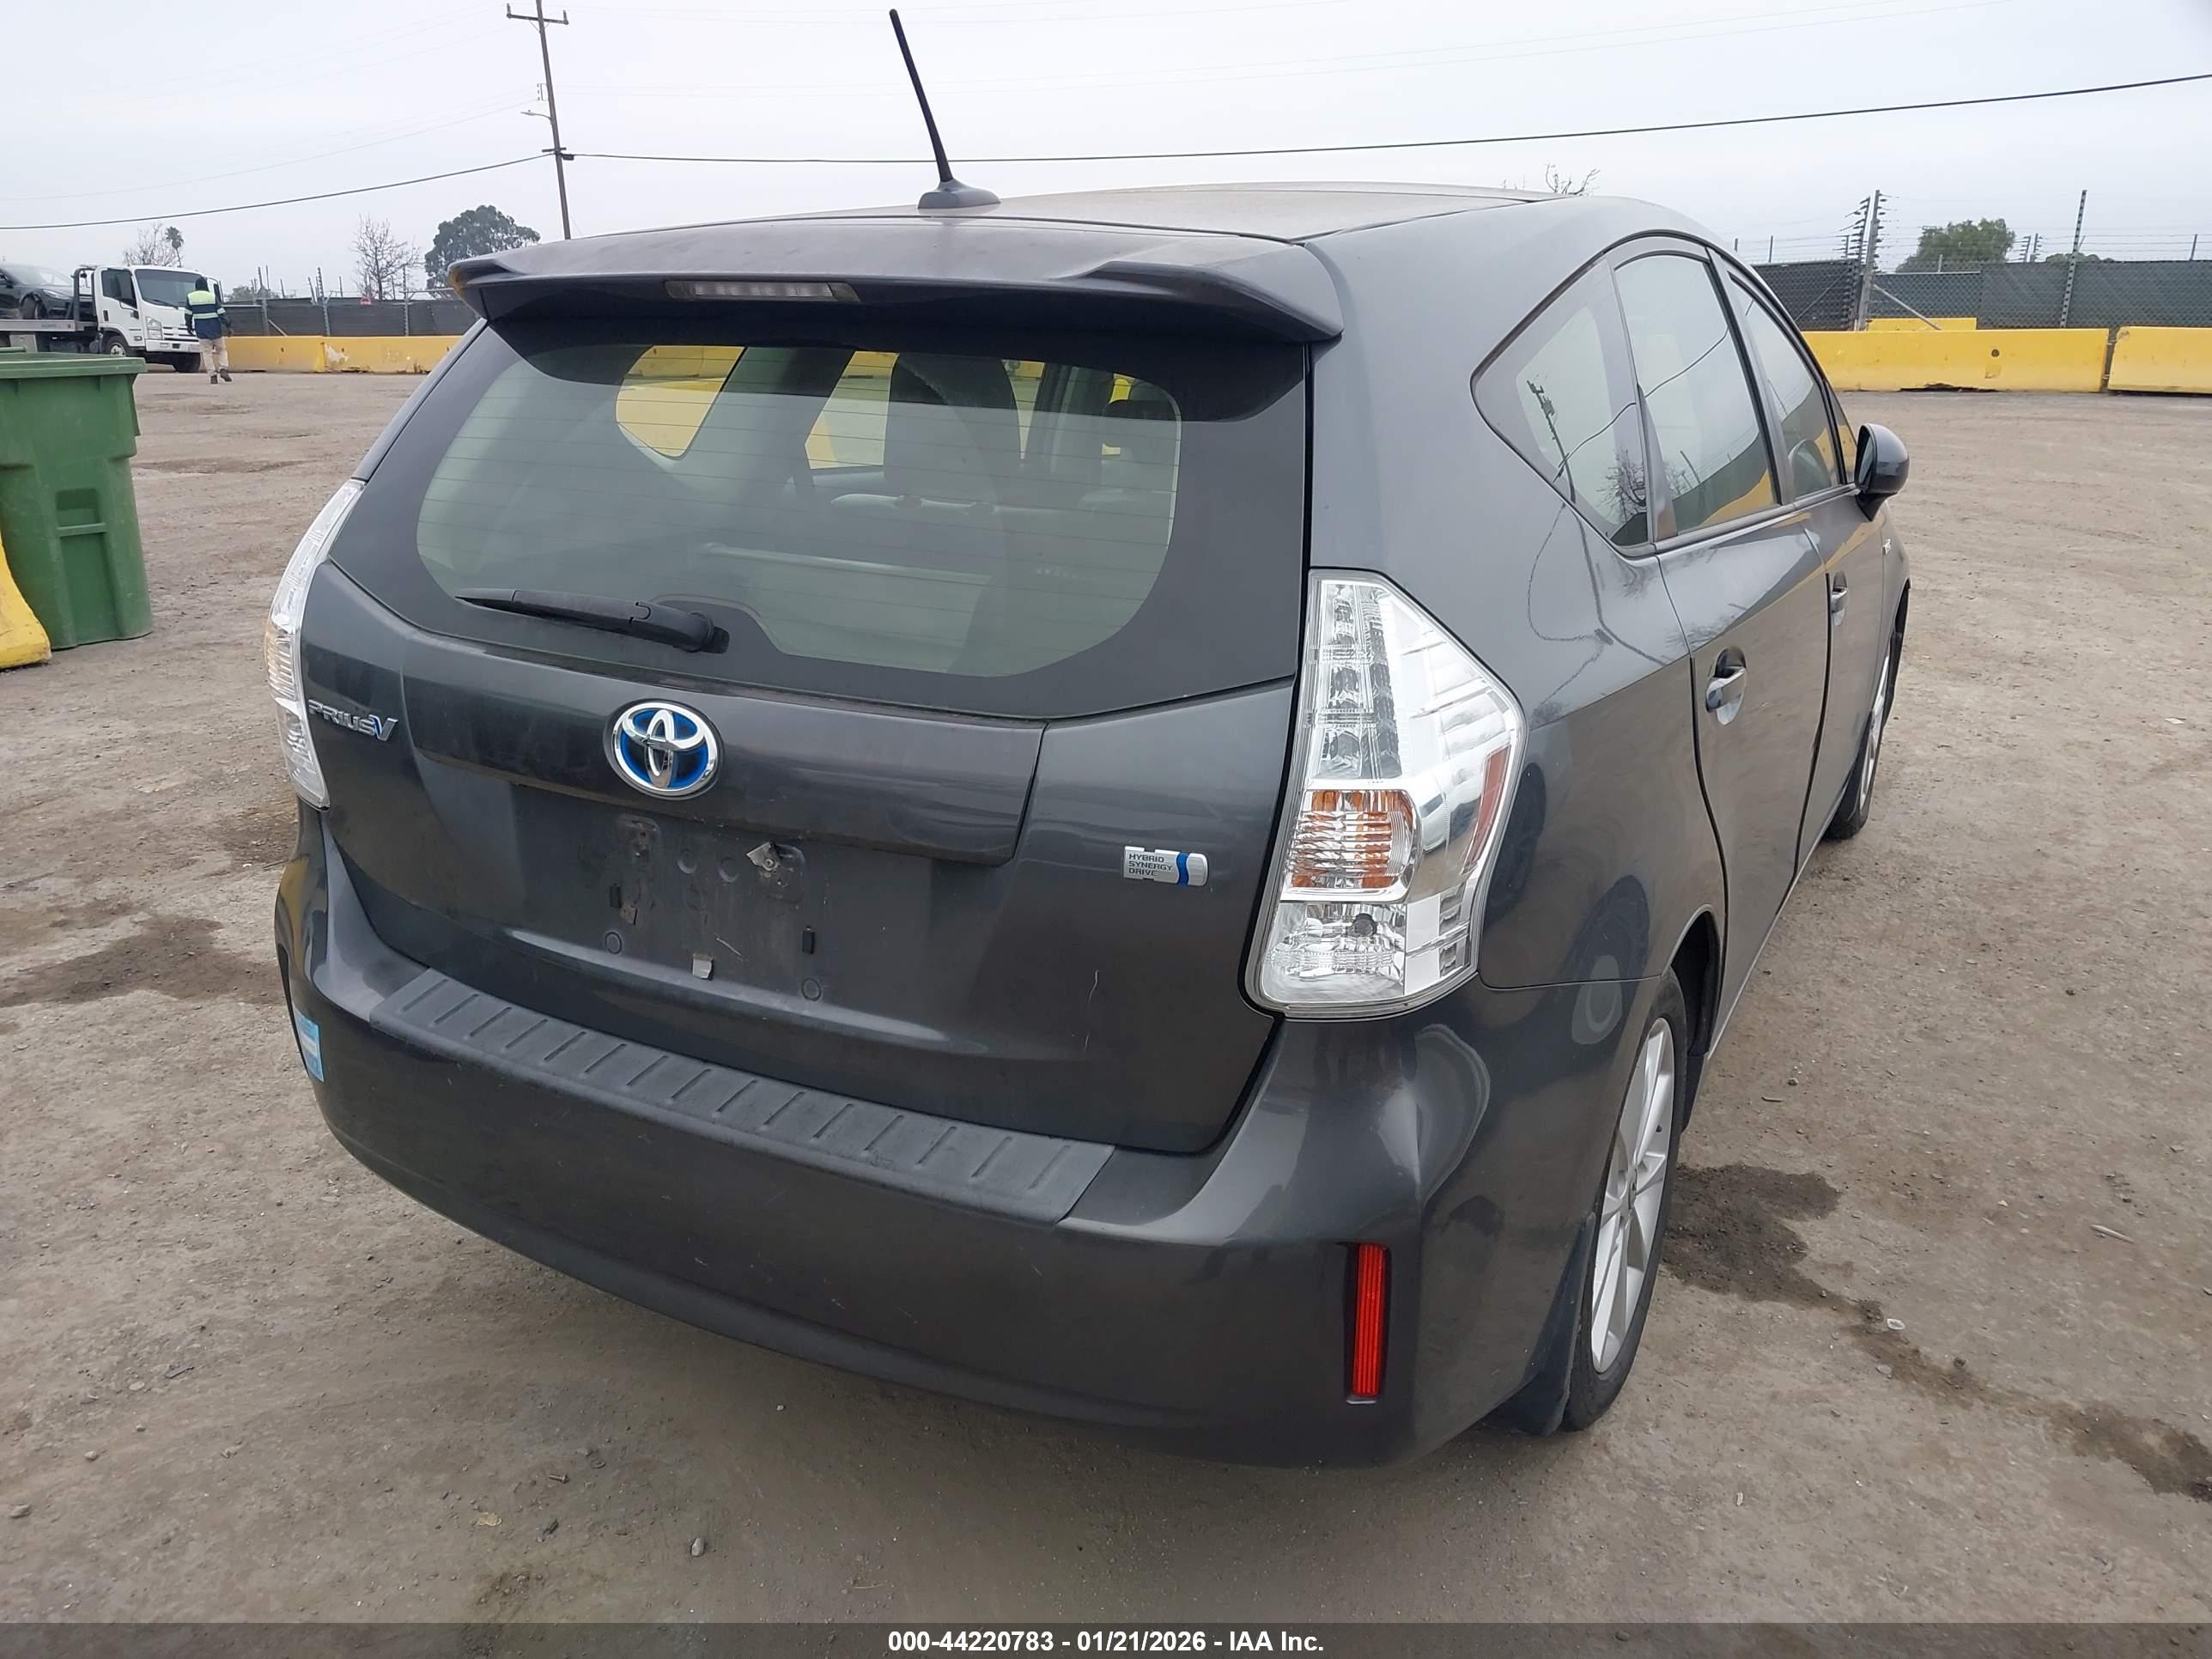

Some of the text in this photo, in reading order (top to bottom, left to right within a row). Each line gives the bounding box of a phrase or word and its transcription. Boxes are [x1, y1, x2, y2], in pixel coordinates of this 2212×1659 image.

[1128, 853, 1165, 863] HYBRID
[1128, 860, 1173, 871] SYNERGY
[1128, 868, 1158, 877] DRIVE
